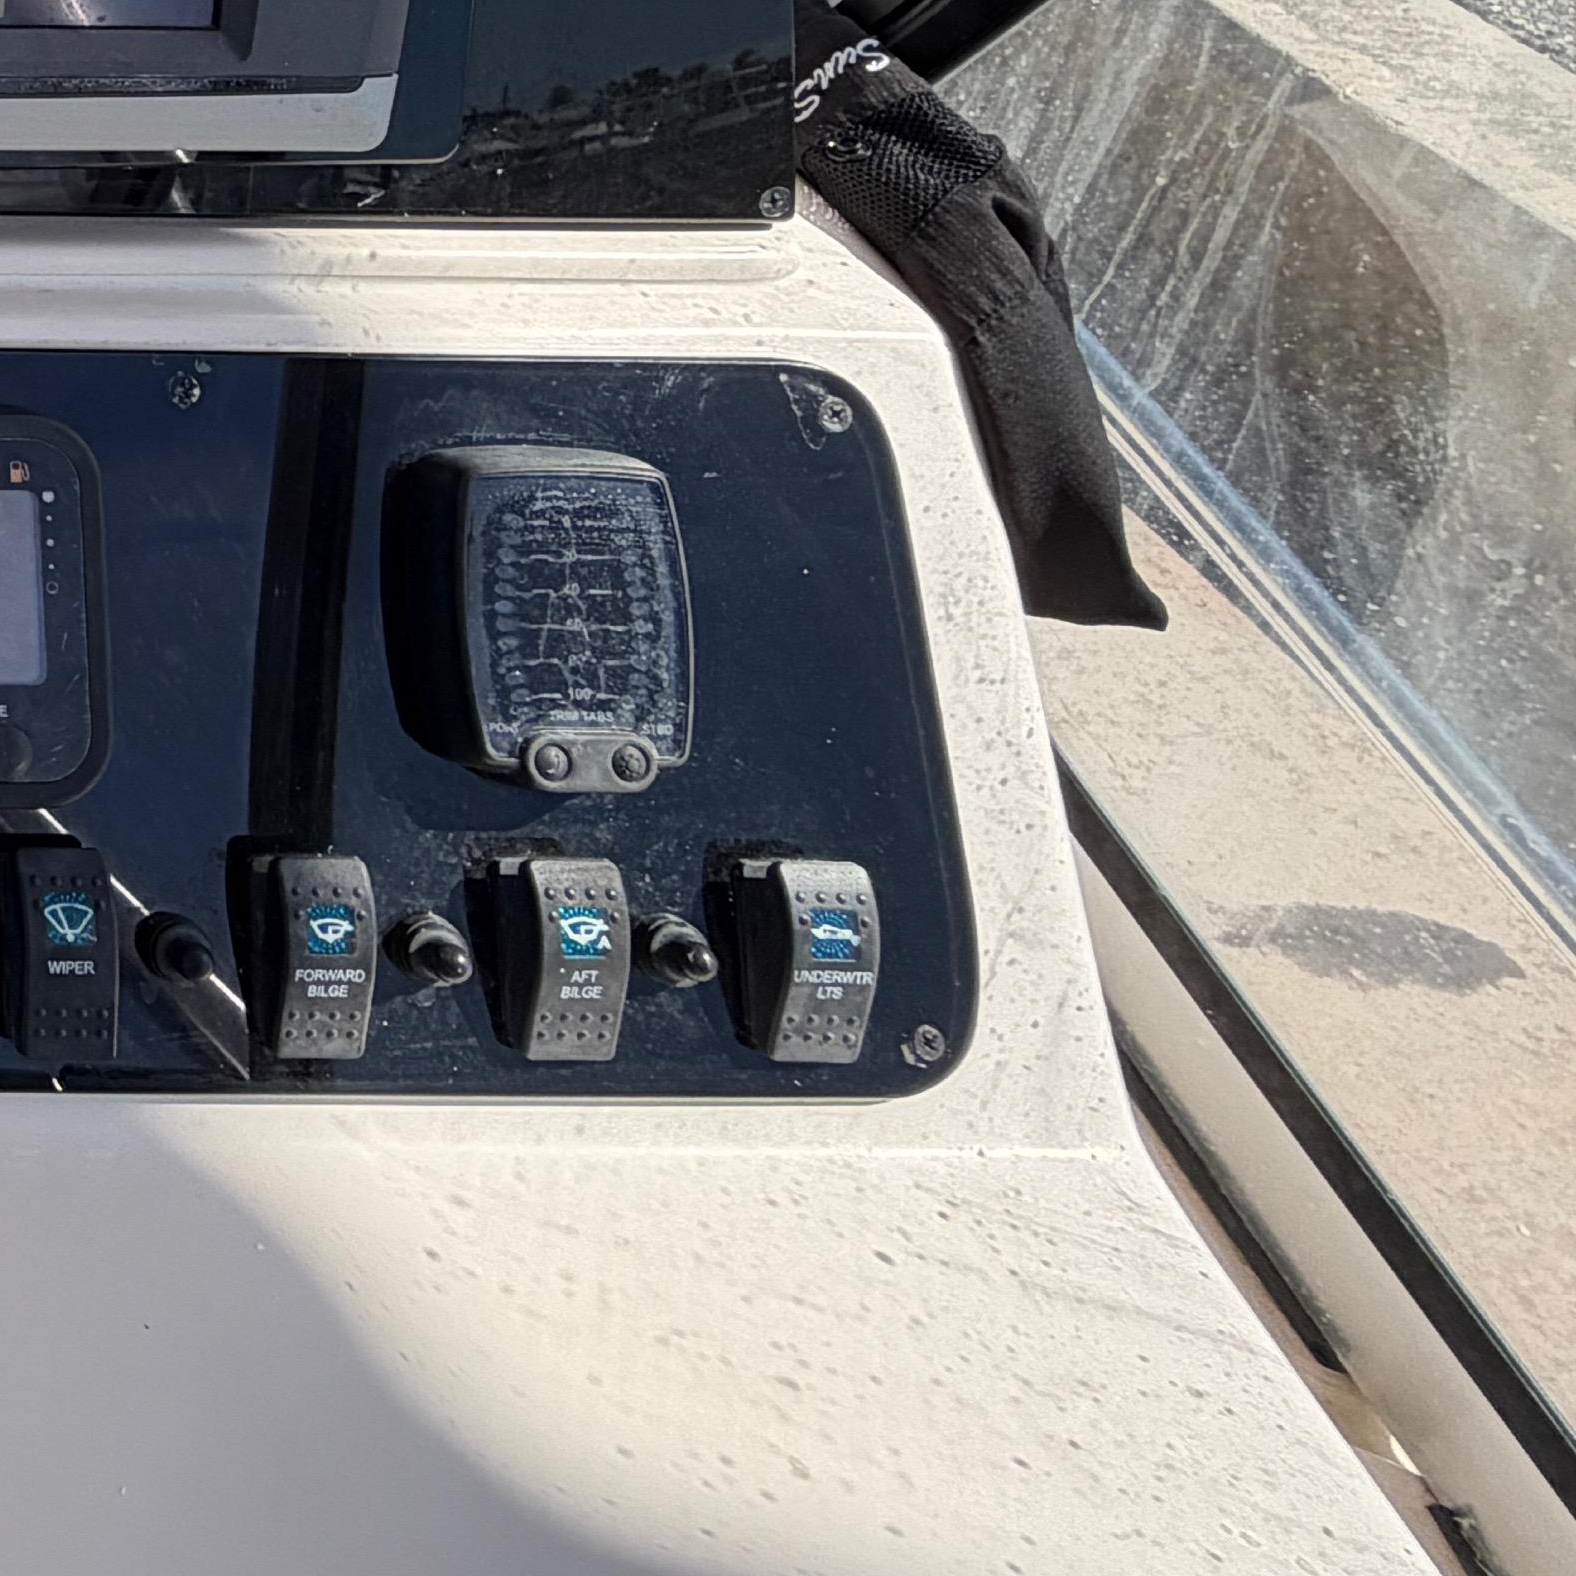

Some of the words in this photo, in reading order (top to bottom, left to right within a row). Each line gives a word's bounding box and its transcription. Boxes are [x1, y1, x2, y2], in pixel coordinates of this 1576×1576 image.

[48, 959, 97, 976] WIPER
[295, 968, 367, 985] FORWARD
[571, 969, 600, 985] AFT
[793, 969, 875, 986] UNDERWTR
[306, 983, 350, 1000] BILGE
[560, 984, 603, 1000] BILGE
[816, 984, 844, 1001] LTS
